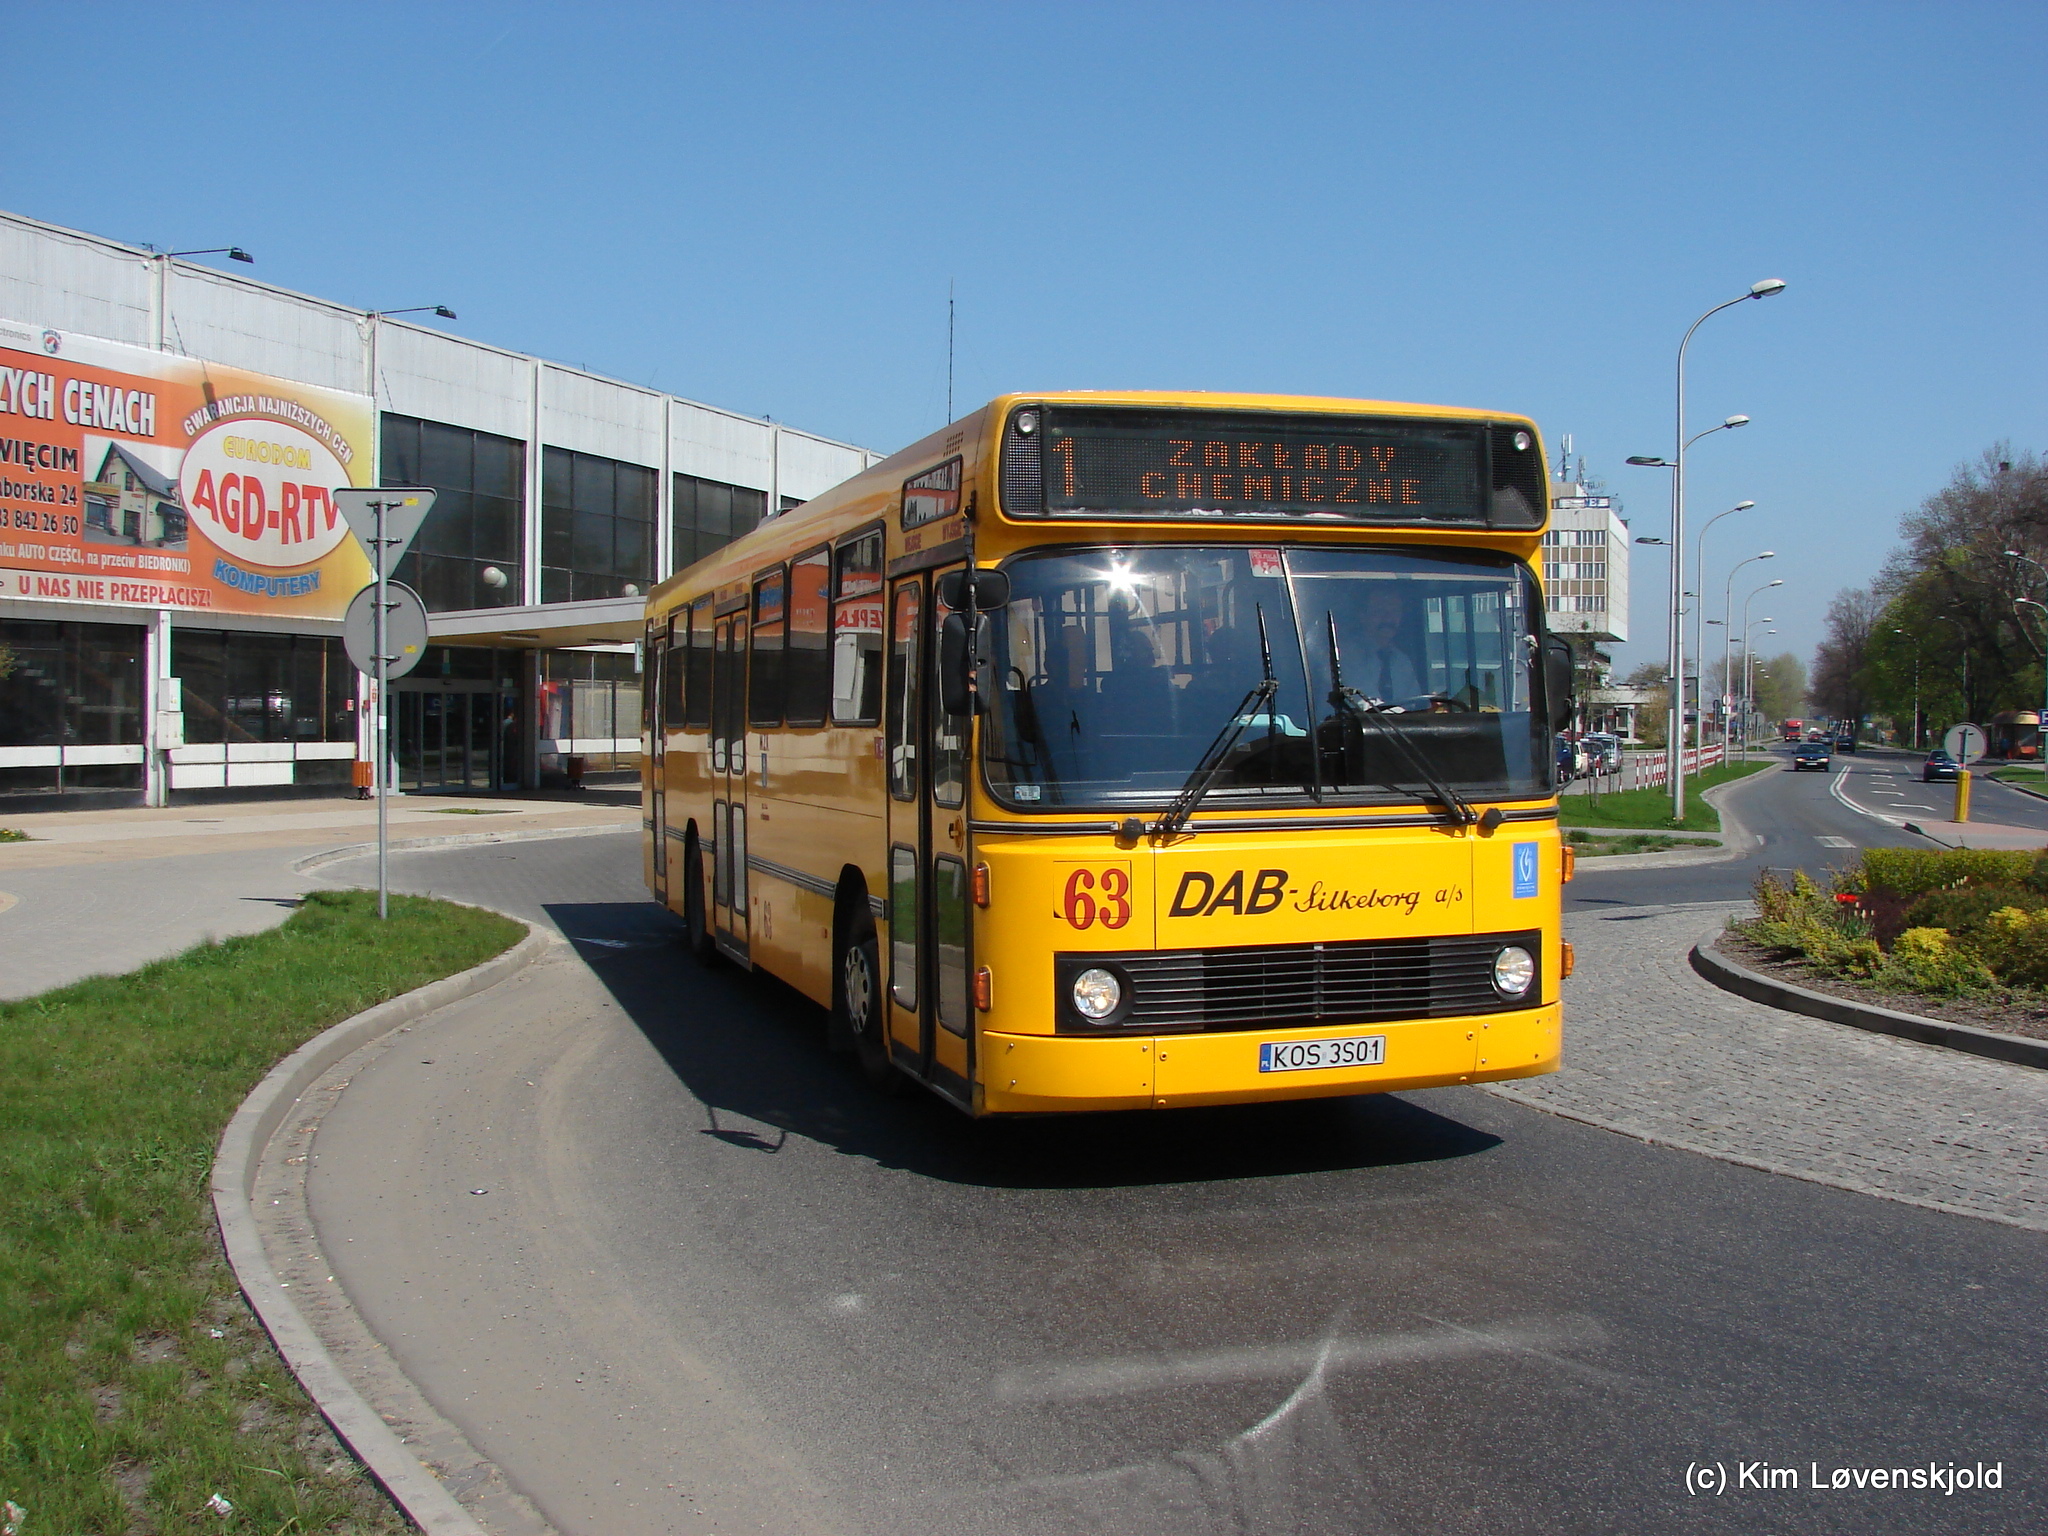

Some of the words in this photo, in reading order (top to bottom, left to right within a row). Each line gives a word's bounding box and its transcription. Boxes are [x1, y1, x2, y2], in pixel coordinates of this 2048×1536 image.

[63, 378, 155, 436] CENACH
[184, 396, 256, 436] GWARANCJA
[259, 396, 332, 440] NAJNIŻSZYCH
[332, 433, 354, 464] CEN
[223, 435, 312, 470] EURODOM
[1051, 437, 1074, 498] 1
[1168, 440, 1396, 472] ZAKŁADY
[60, 484, 78, 506] 24
[1141, 472, 1422, 505] CHEMICZNE
[14, 510, 38, 531] 842
[42, 513, 58, 533] 26
[63, 515, 79, 536] 50
[191, 468, 341, 546] AGD-RTV
[18, 543, 46, 561] AUTO
[87, 553, 99, 565] na
[101, 552, 136, 569] przeciw
[138, 556, 191, 575] BIEDRONKI)
[19, 575, 31, 594] U
[37, 577, 71, 598] NAS
[77, 580, 104, 600] NIE
[110, 583, 212, 608] PRZEPŁACISZ!
[213, 558, 322, 597] KOMPUTERY
[1064, 868, 1130, 930] 63
[1435, 883, 1464, 909] a/s
[1274, 1044, 1321, 1067] KOS
[1329, 1040, 1379, 1063] 3S01
